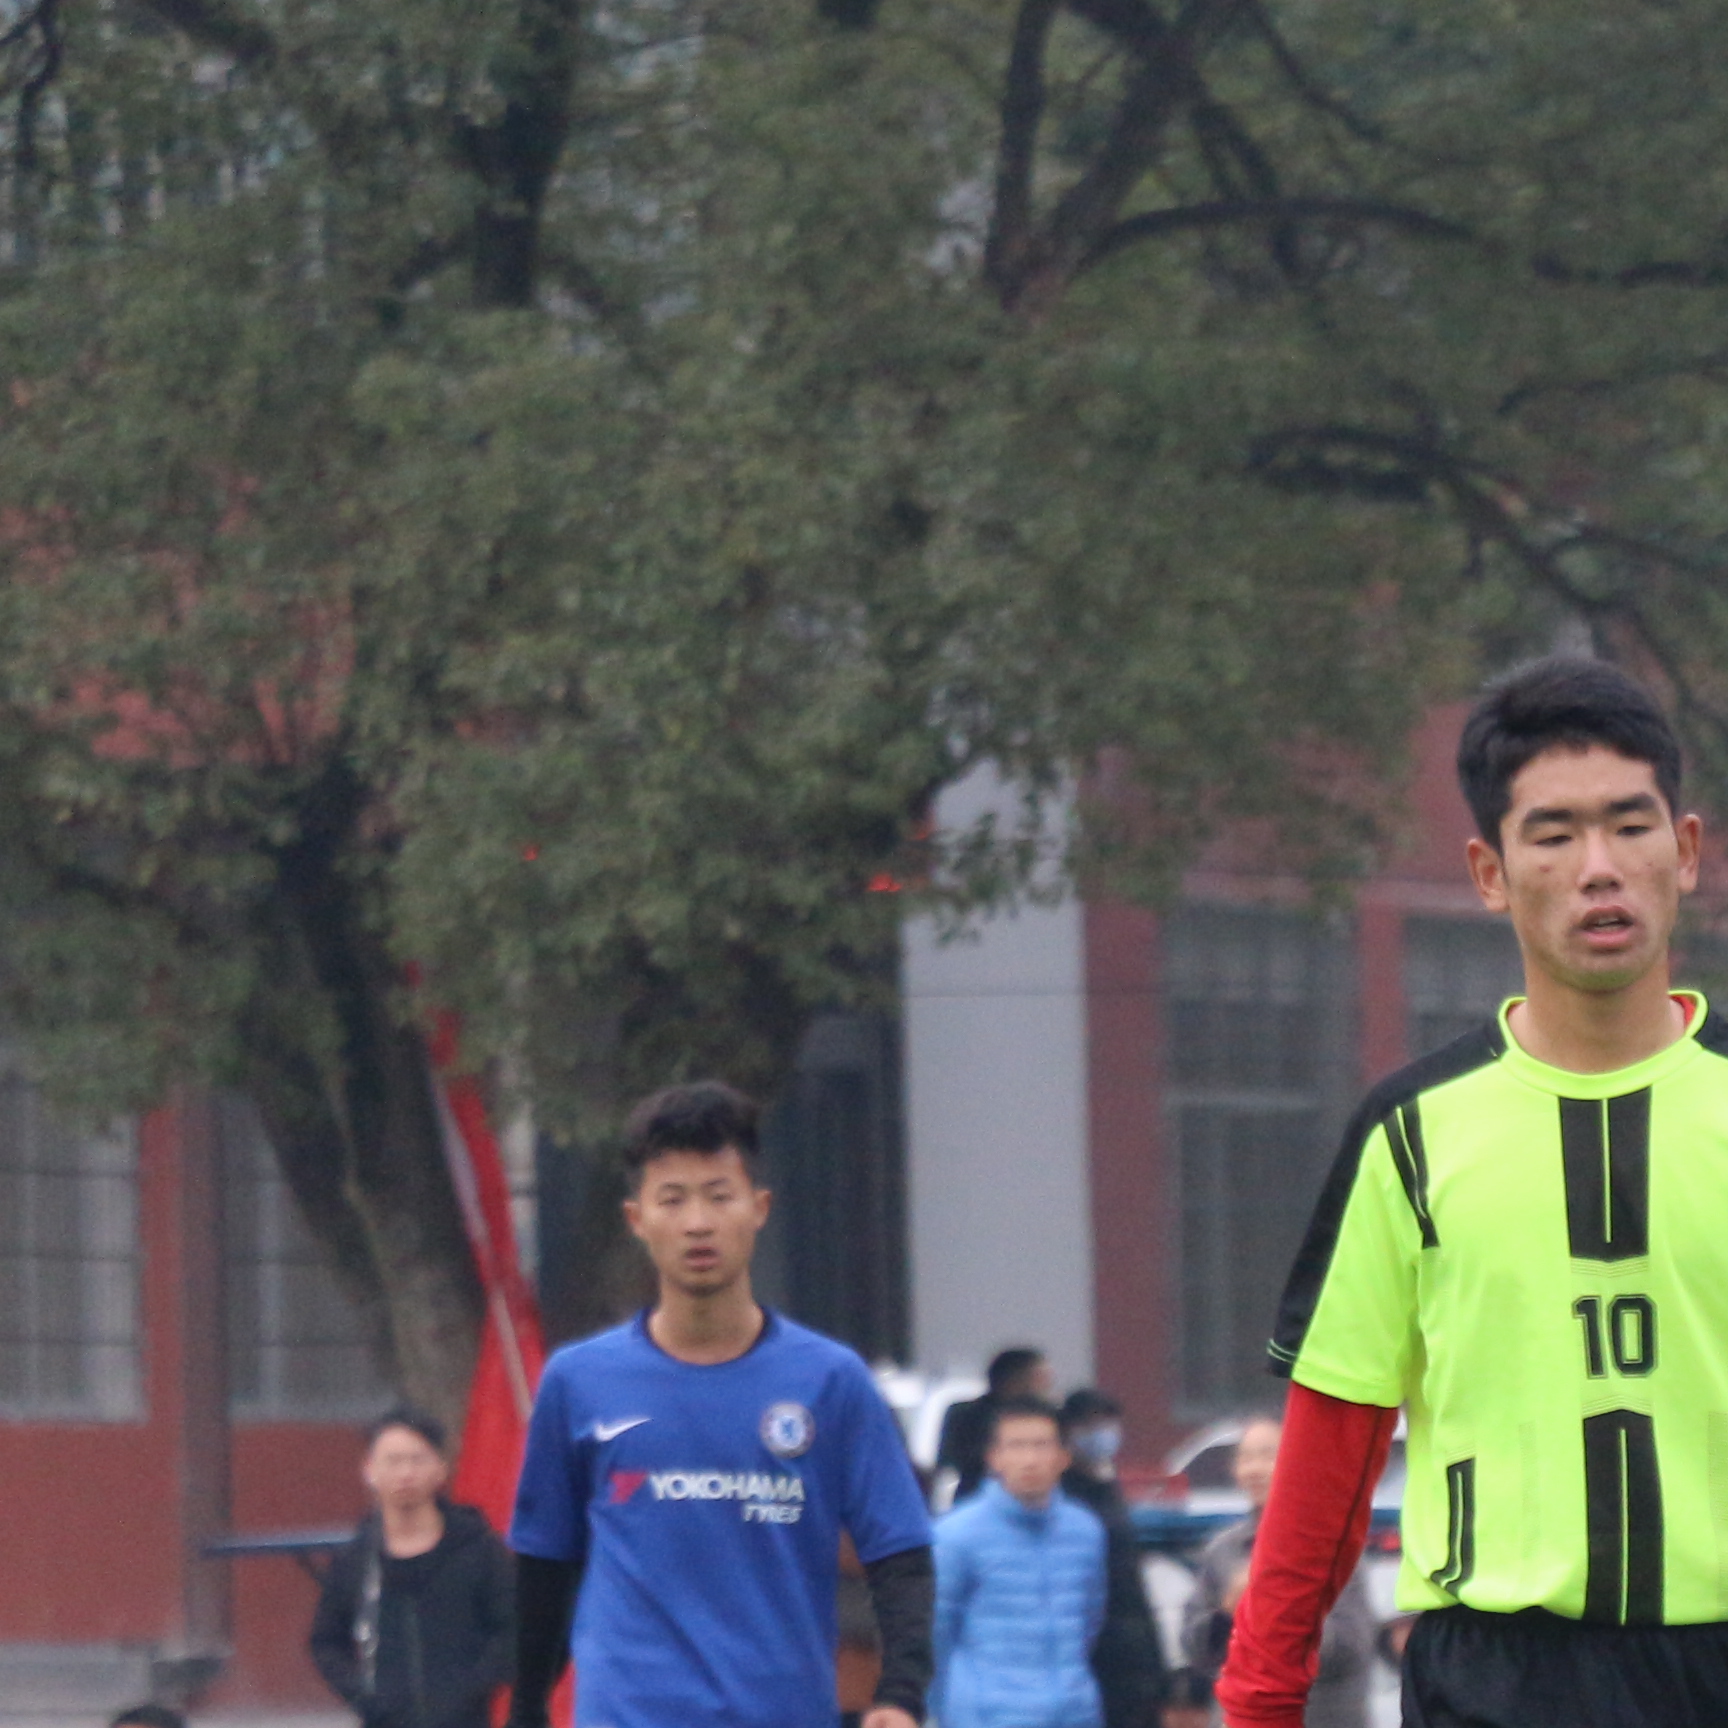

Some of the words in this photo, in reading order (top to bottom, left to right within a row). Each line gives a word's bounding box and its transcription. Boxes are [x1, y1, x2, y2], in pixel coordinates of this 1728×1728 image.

[1574, 1295, 1658, 1378] 10
[649, 1473, 804, 1500] YOKOHAMA
[743, 1503, 803, 1524] TYRES
